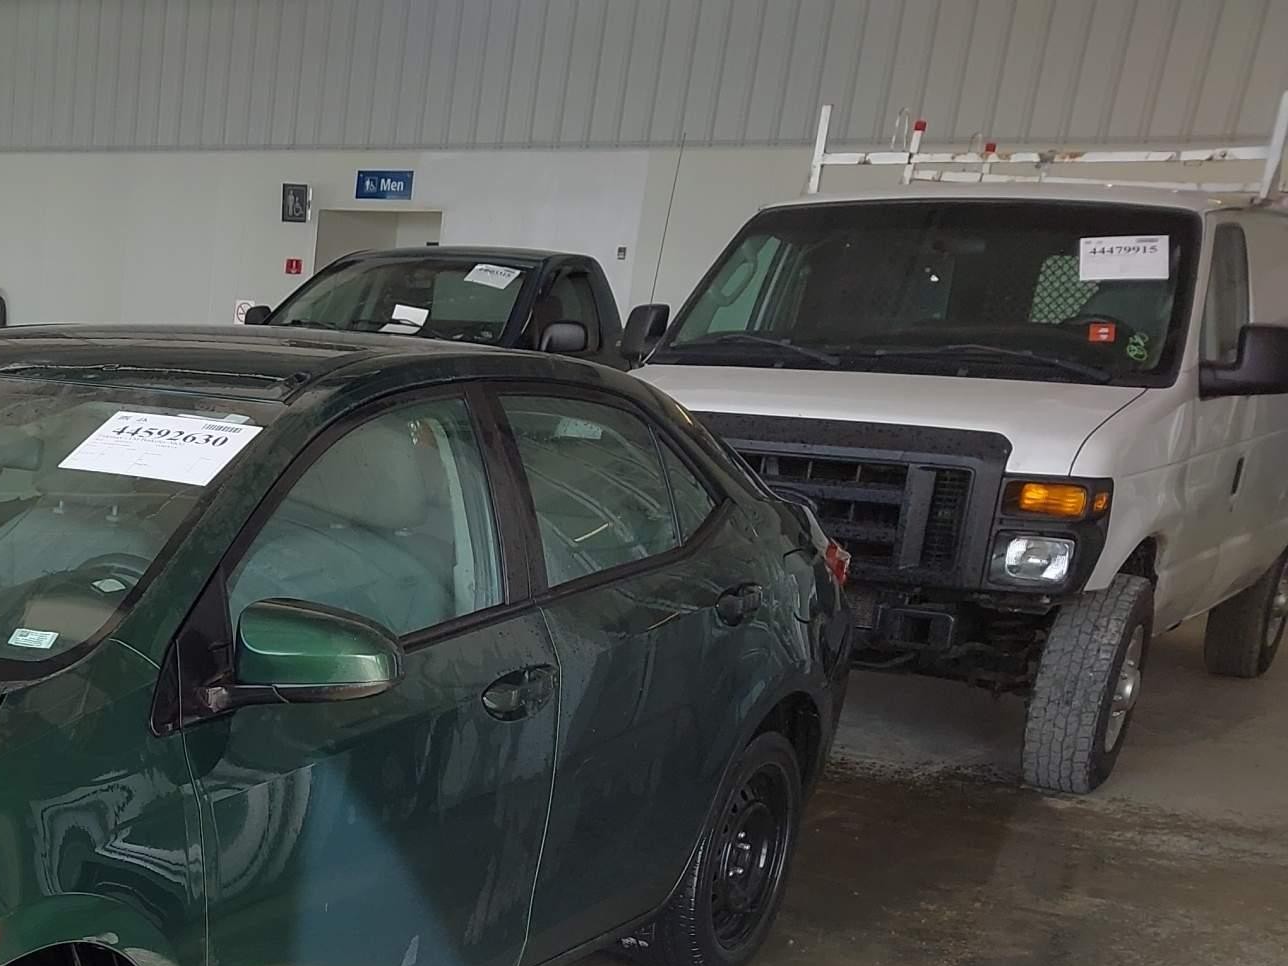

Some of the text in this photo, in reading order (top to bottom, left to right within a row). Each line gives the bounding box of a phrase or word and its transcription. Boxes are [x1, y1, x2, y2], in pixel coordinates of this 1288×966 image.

[380, 178, 404, 192] Men
[1089, 245, 1159, 255] 44479915
[112, 426, 229, 447] 44592630
